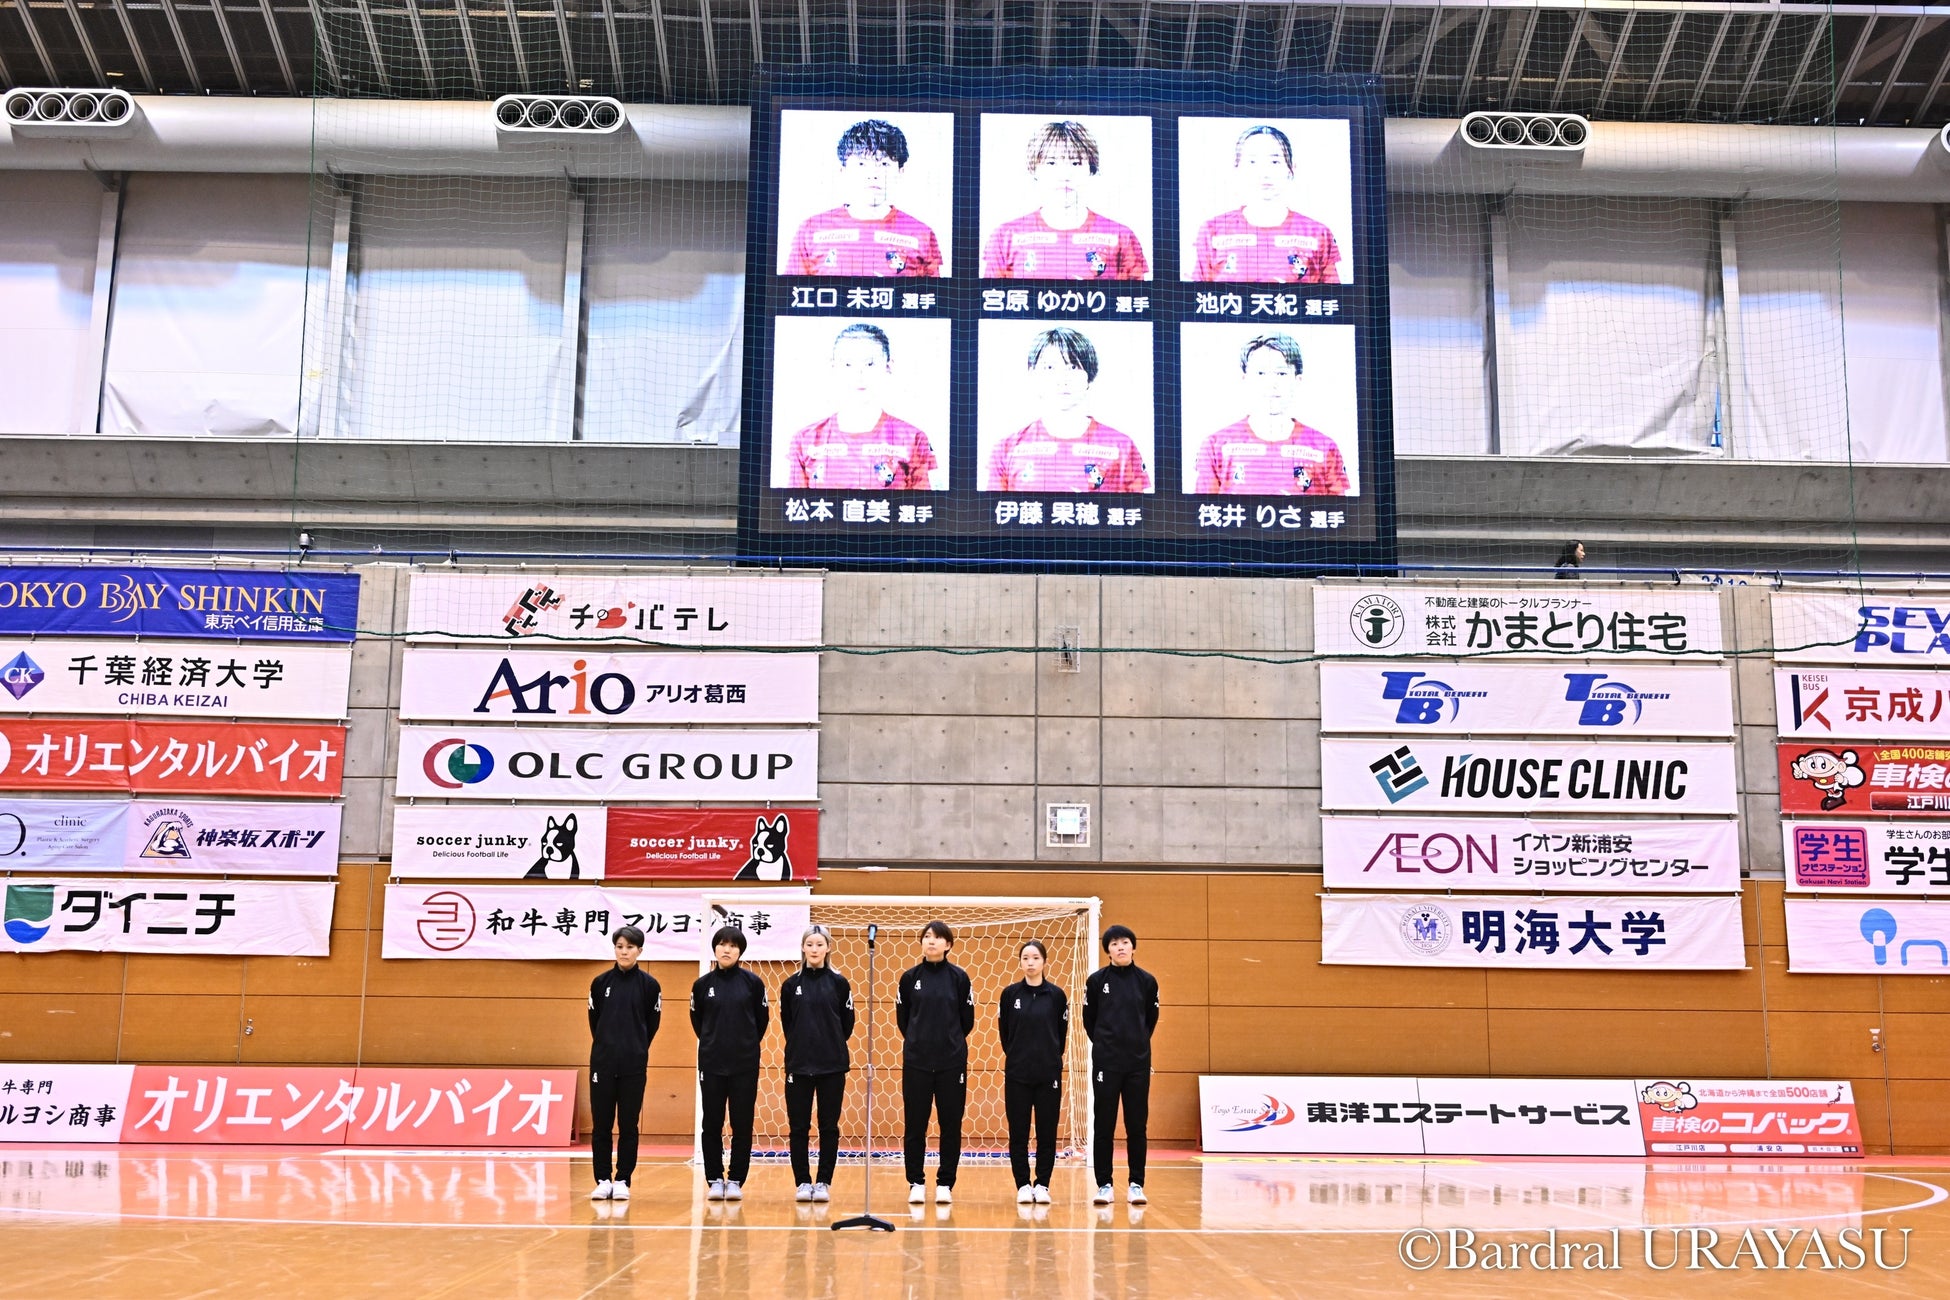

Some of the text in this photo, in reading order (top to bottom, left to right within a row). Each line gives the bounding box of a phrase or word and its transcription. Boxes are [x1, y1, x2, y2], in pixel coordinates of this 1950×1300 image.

[791, 286, 838, 308] 江口
[902, 293, 936, 310] 選手
[982, 288, 1150, 313] 宮原 ゆかり 選手
[1195, 292, 1340, 316] 池内 天紀 選手
[785, 497, 934, 523] 松本 直美 選手
[995, 501, 1142, 526] 伊藤 果穂 選手
[1198, 503, 1345, 528] 筏井 りさ 選手
[178, 584, 327, 615] SHINKIN
[1424, 596, 1592, 609] 不動産と建築のトータルプランナー
[205, 615, 324, 633] 東京ベイ信用金庫
[1466, 610, 1688, 650] かまとり住宅
[4, 667, 36, 685] CK
[68, 655, 285, 690] 千葉経済大学
[1802, 674, 1828, 682] KEISEI
[473, 657, 636, 716] Ario
[646, 684, 747, 704] アリオ葛西
[1408, 690, 1489, 698] TOTAL BENEFIT
[1591, 692, 1671, 700] TOTAL BENEFIT
[1803, 683, 1820, 691] BUS
[118, 692, 228, 708] CHIBA KEIZAI
[21, 733, 337, 784] オリエンタルバイオ
[508, 752, 794, 780] OLC GROUP
[1441, 753, 1688, 802] HOUSE CLINIC
[1907, 795, 1950, 809] 江戸川
[54, 815, 87, 826] clinic
[143, 808, 194, 829] KAGURAZAKA SPORTS
[196, 829, 326, 849] 神楽坂スポーツ
[416, 833, 529, 849] soccer junky
[630, 835, 740, 850] soccer junky
[1513, 833, 1633, 854] イオン新浦安
[1800, 833, 1862, 861] 学生
[679, 852, 708, 860] Football
[1513, 857, 1709, 878] ショッピングセンター
[60, 890, 236, 935] ダイニチ
[486, 907, 610, 937] 和牛専門
[1462, 910, 1667, 956] 明海大学
[1, 1079, 53, 1095] 牛専門
[1699, 1086, 1829, 1099] 北海道から沖縄まで全国500店舗
[134, 1075, 563, 1137] オリエンタルバイオ
[1231, 1105, 1258, 1115] Estate
[1306, 1101, 1631, 1126] 東洋エステートサービス
[1651, 1111, 1850, 1136] 車検のコバック
